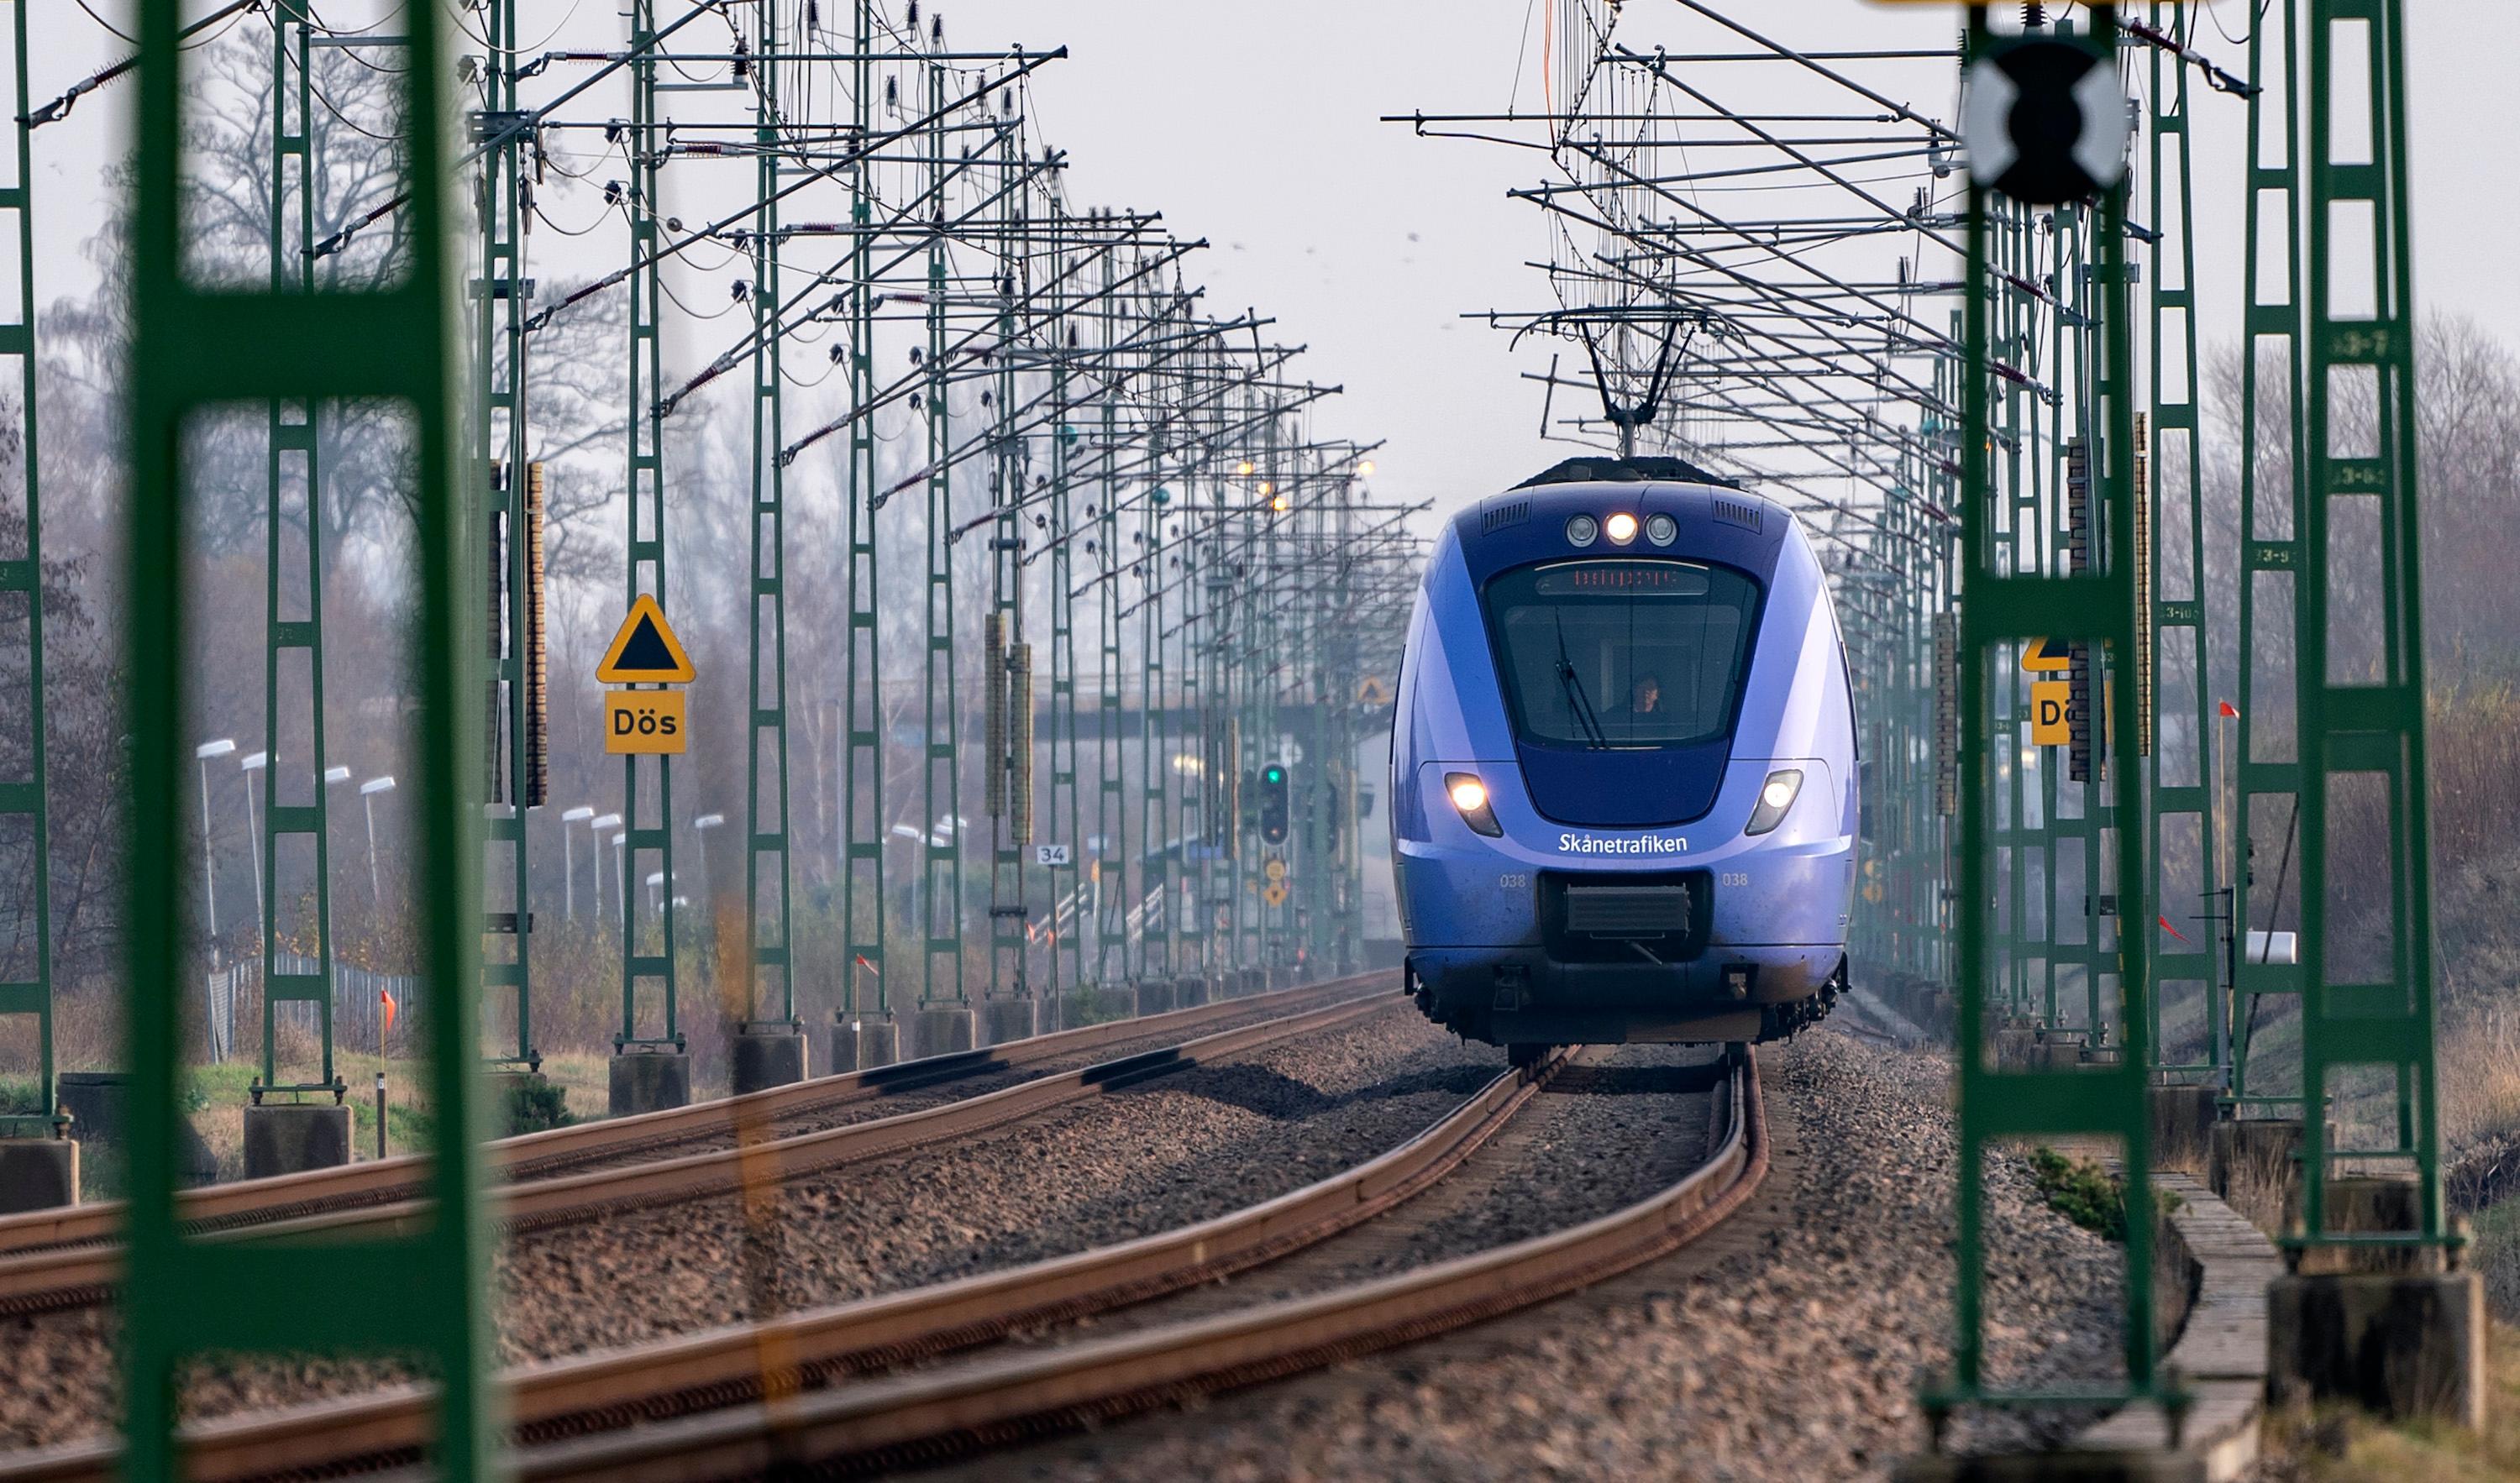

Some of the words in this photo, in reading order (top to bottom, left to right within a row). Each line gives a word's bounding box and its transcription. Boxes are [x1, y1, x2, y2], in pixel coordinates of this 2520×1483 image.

[613, 709, 678, 736] Dös
[1558, 832, 1688, 855] Skånetrafiken
[1041, 847, 1064, 862] 34
[1499, 873, 1527, 889] 038
[1722, 872, 1748, 888] 038
